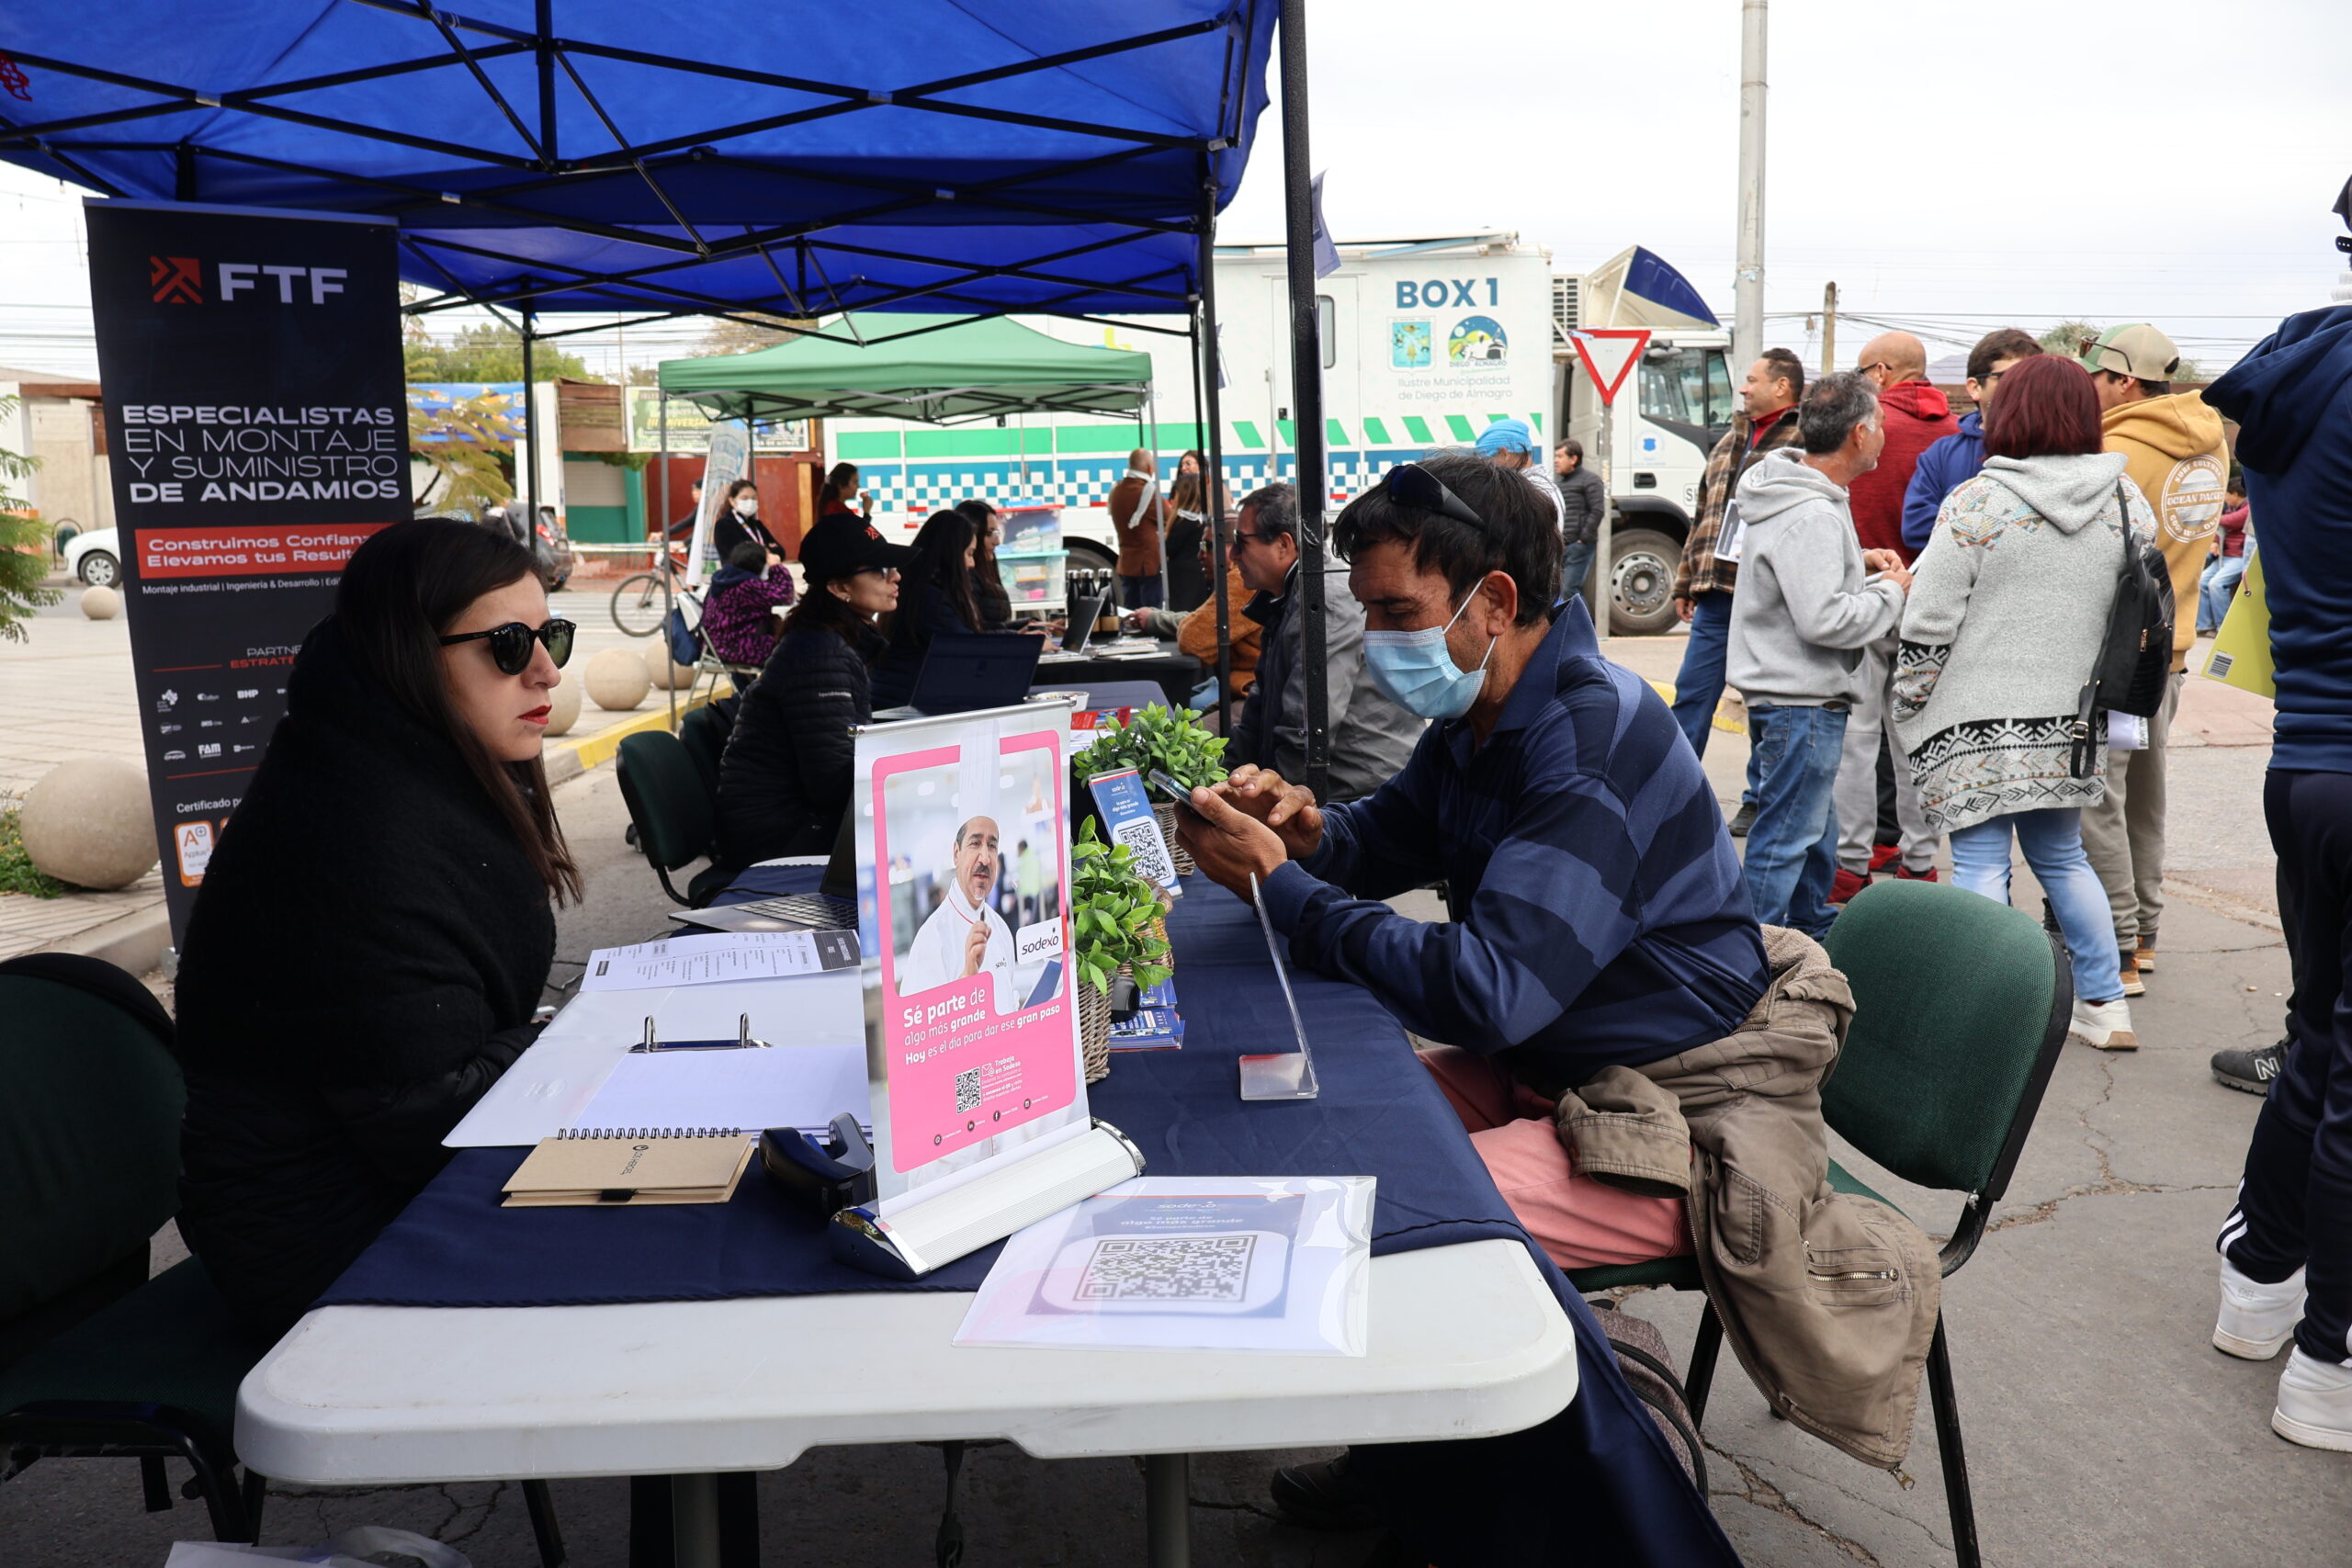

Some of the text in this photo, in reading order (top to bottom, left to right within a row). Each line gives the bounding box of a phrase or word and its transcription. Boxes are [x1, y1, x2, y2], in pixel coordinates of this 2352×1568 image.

[219, 263, 348, 304] FTF
[1396, 277, 1498, 309] BOX 1
[1397, 375, 1510, 389] Ilustre Municipalidad
[1397, 388, 1513, 402] de Diego de Almagro
[122, 405, 395, 425] ESPECIALISTAS
[124, 428, 397, 453] EN MONTAJE
[129, 455, 399, 479] Y SUMINISTRO
[130, 479, 401, 503] DE ANDAMIOS
[2167, 493, 2198, 506] OCEAN
[149, 536, 280, 552] Construimos
[147, 548, 353, 568] Elevamos tus Result
[142, 585, 179, 596] Montaje
[180, 582, 220, 593] industrial
[226, 579, 268, 592] Ingeniería
[269, 580, 277, 589] &
[277, 578, 320, 589] Desarrollo
[236, 688, 259, 700] BHP
[198, 742, 221, 756] FAM
[176, 797, 231, 813] Certificado
[1022, 932, 1059, 955] sodexo
[903, 987, 986, 1028] Sé parte de
[904, 1008, 986, 1046] algo más grande
[905, 1004, 1060, 1066] Hoy es el día para dar ese gran paso
